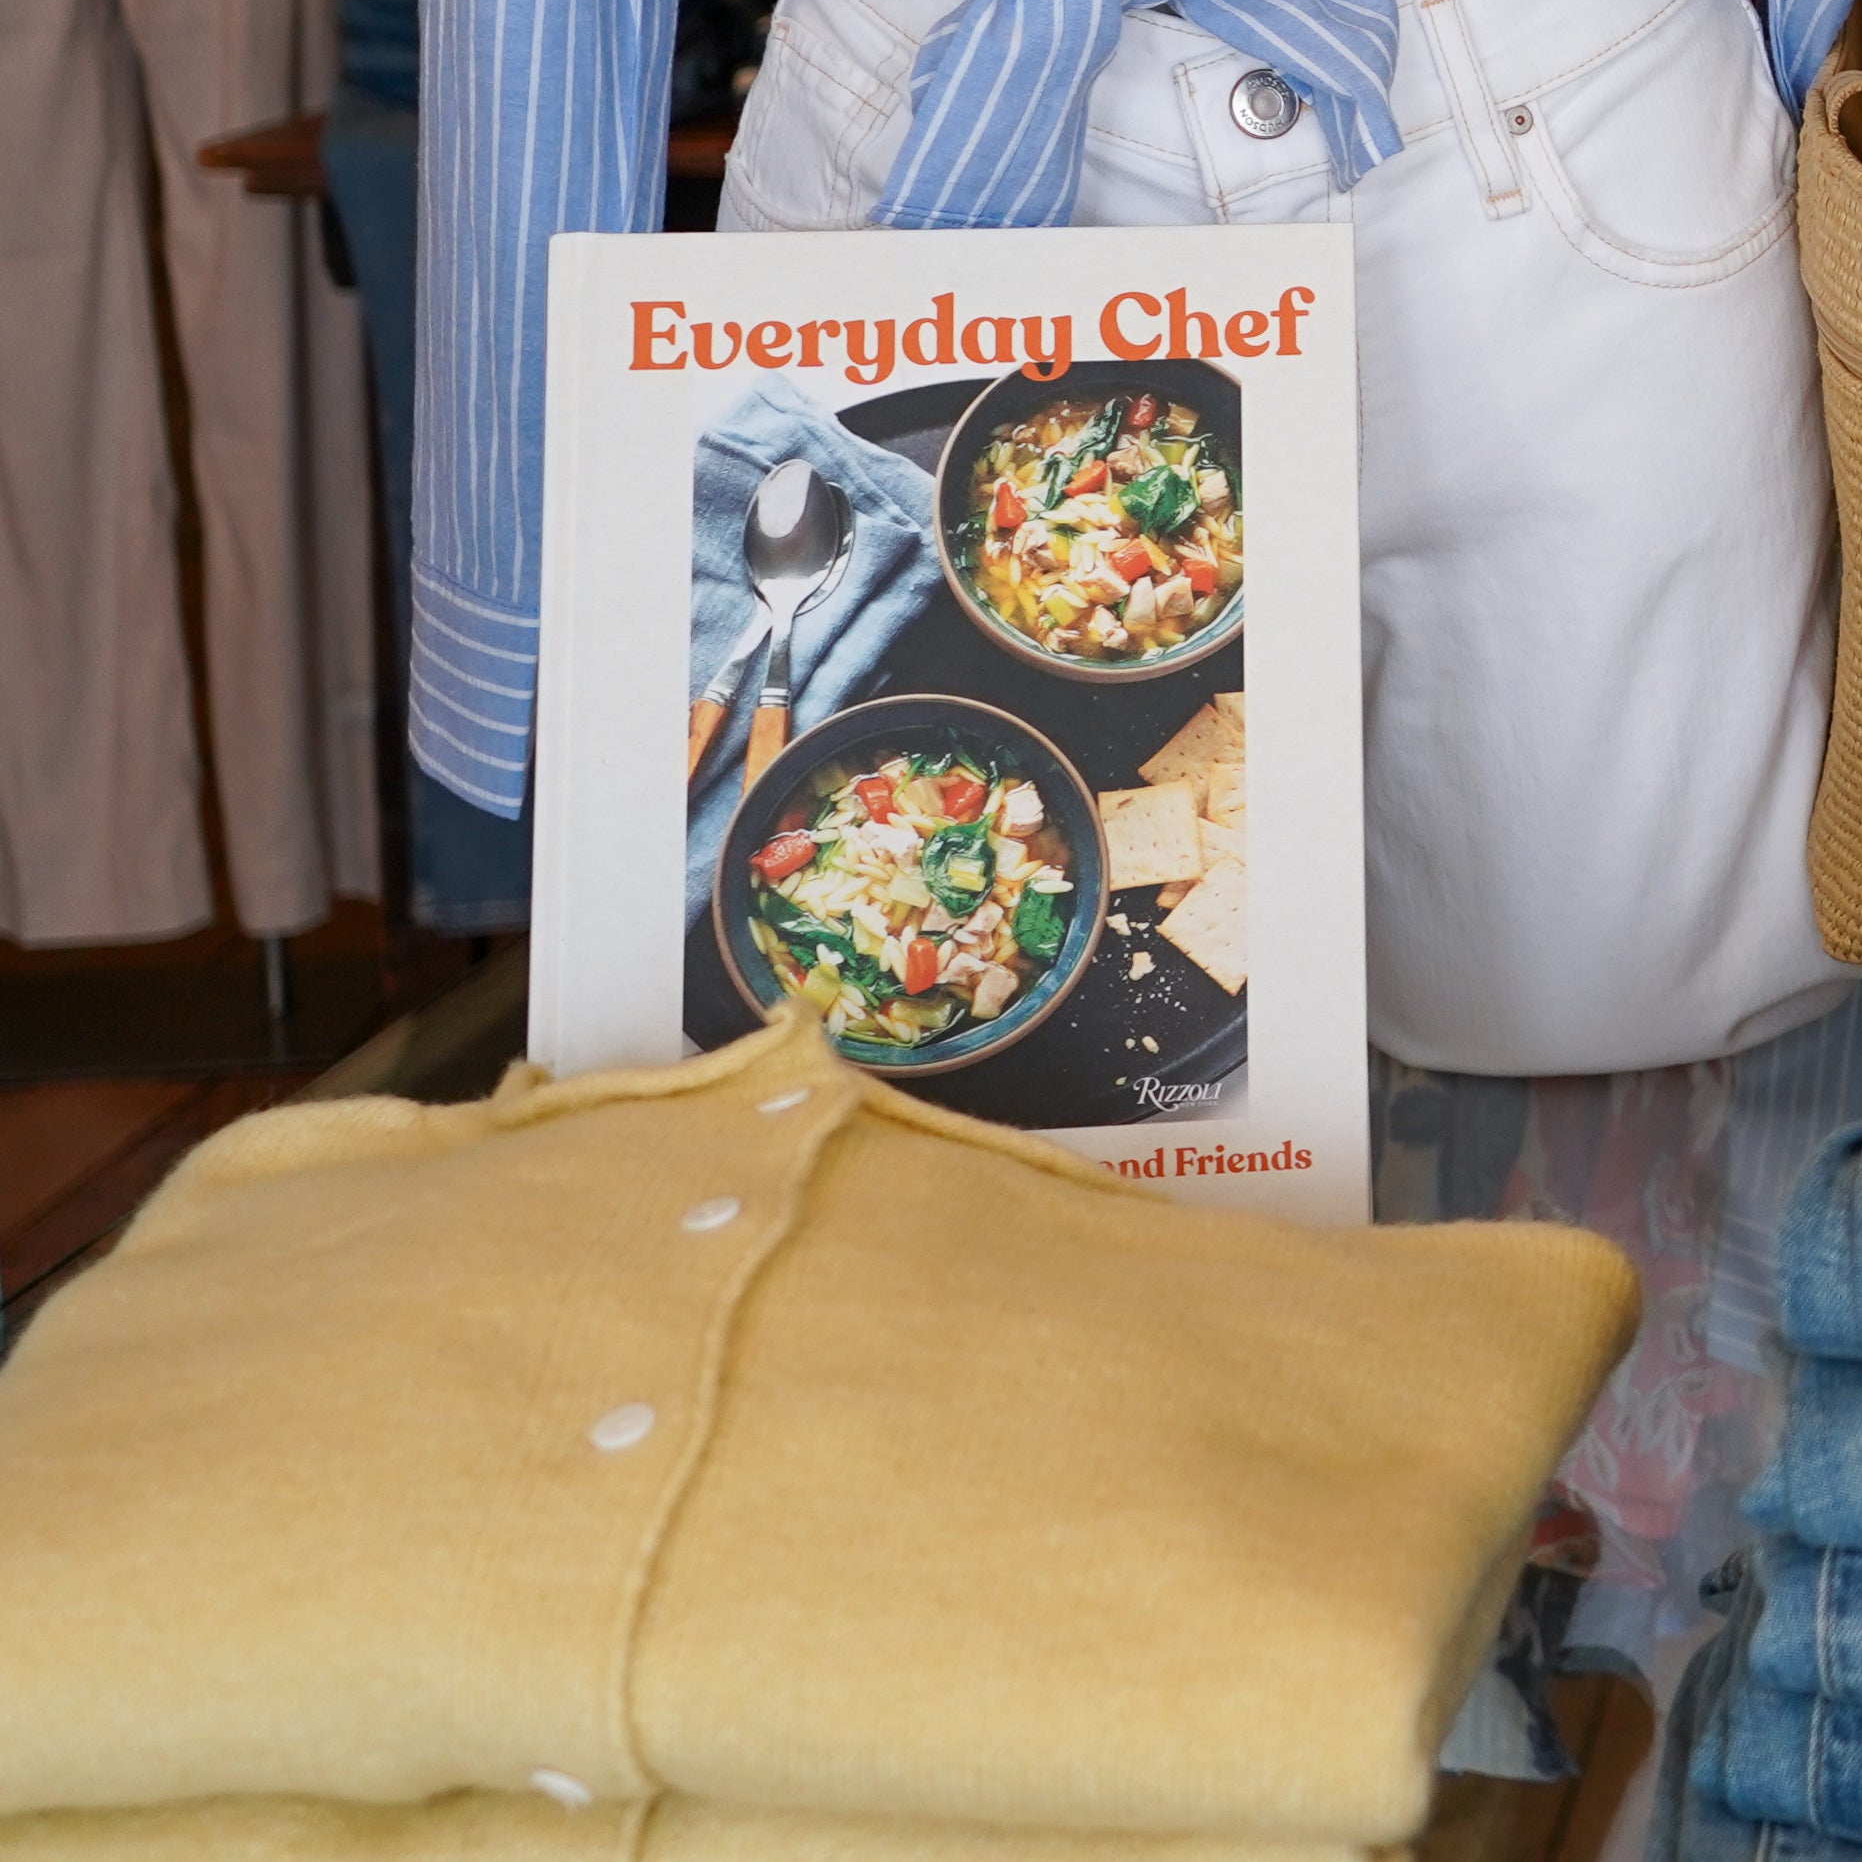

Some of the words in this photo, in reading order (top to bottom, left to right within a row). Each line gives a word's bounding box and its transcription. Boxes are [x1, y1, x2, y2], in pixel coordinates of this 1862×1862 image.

[1239, 108, 1286, 133] HUDSON
[629, 291, 1073, 384] Everyday
[1099, 286, 1315, 362] Chef
[1175, 1139, 1313, 1177] Friends
